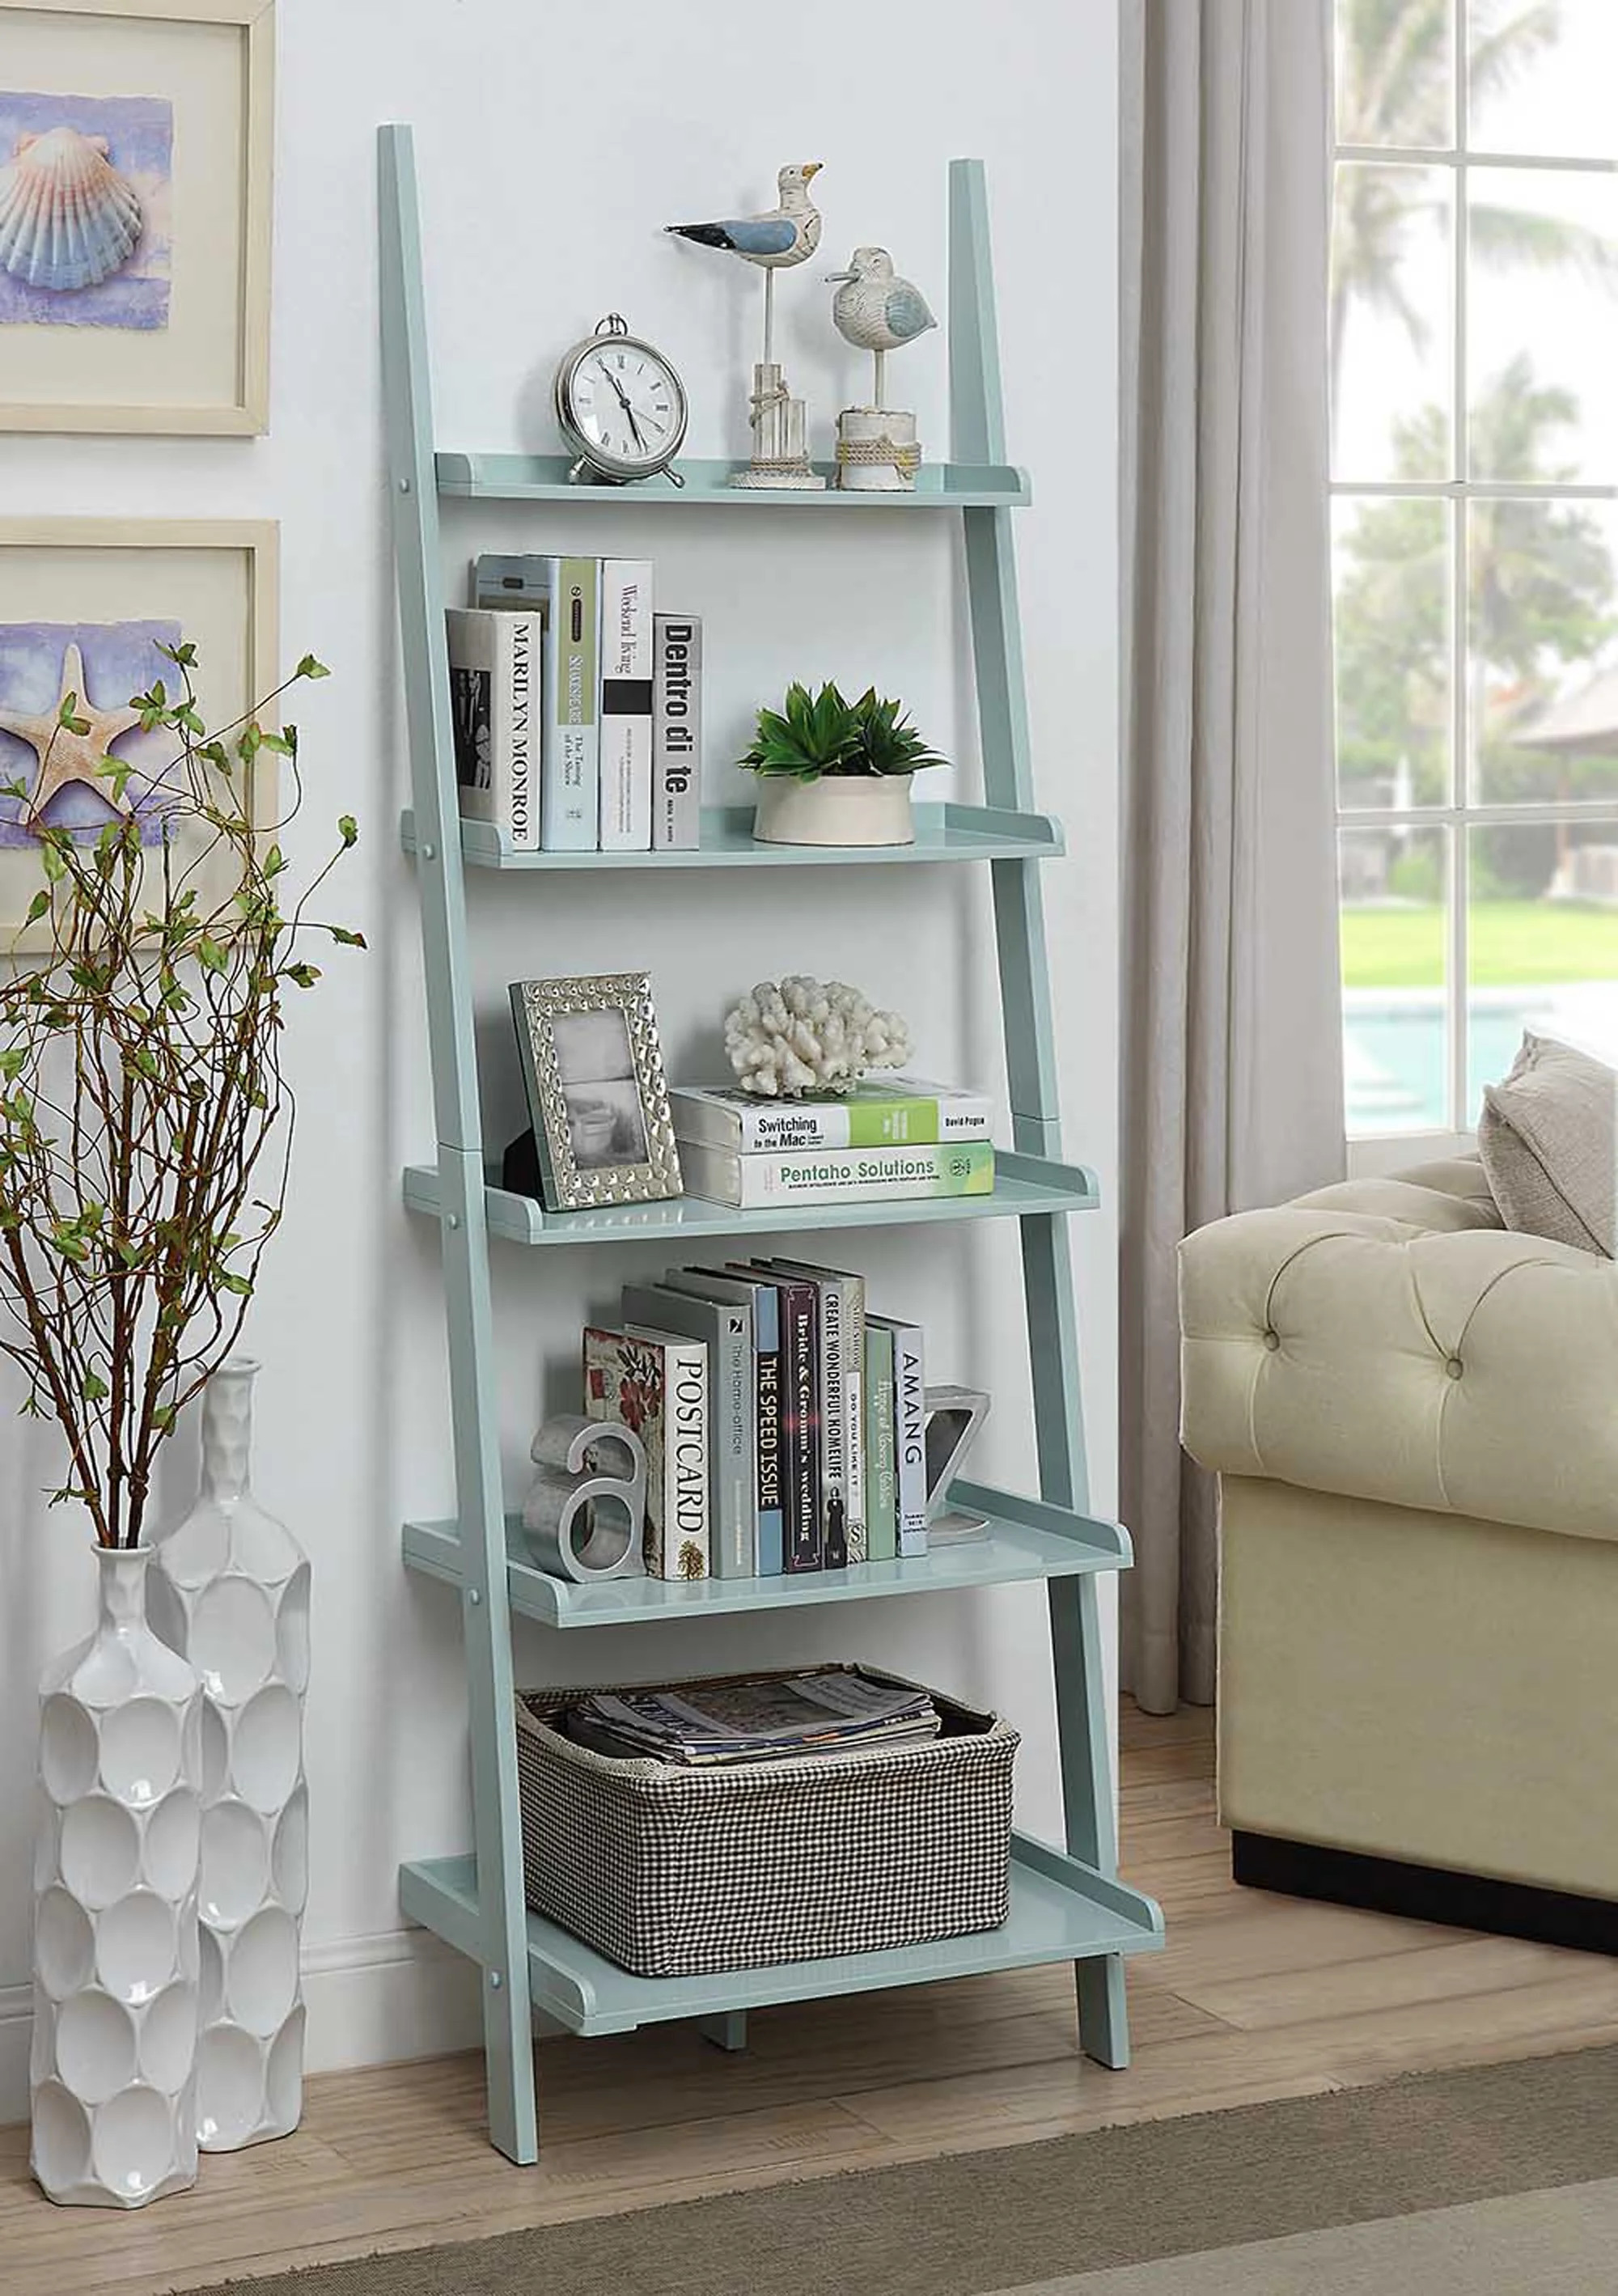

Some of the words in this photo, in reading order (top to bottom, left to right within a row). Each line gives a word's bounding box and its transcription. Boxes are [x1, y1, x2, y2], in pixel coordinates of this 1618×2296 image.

[621, 584, 638, 638] Weekend
[511, 623, 530, 735] MARILYN
[664, 624, 693, 717] Dentro
[665, 727, 693, 752] di
[510, 738, 530, 842] MONROE
[664, 765, 691, 794] te
[754, 1139, 762, 1148] to
[764, 1138, 777, 1148] the
[779, 1133, 807, 1147] Mac
[758, 1116, 817, 1133] Switching
[945, 1117, 964, 1127] David
[781, 1163, 851, 1183] Pentaho
[858, 1159, 934, 1178] Solutions
[797, 1314, 809, 1362] Bride
[825, 1293, 840, 1337] CREATE
[732, 1345, 743, 1366] The
[759, 1357, 777, 1392] THE
[797, 1366, 809, 1382] &
[826, 1341, 841, 1417] WONDERFUL
[759, 1396, 777, 1449] SPEED
[798, 1384, 811, 1464] Gromm's
[902, 1352, 922, 1465] AMANG
[676, 1358, 704, 1533] POSTCARD
[827, 1419, 842, 1480] HOMELIFE
[850, 1443, 858, 1469] LIKE
[760, 1454, 778, 1506] ISSUE
[799, 1471, 811, 1542] wedding
